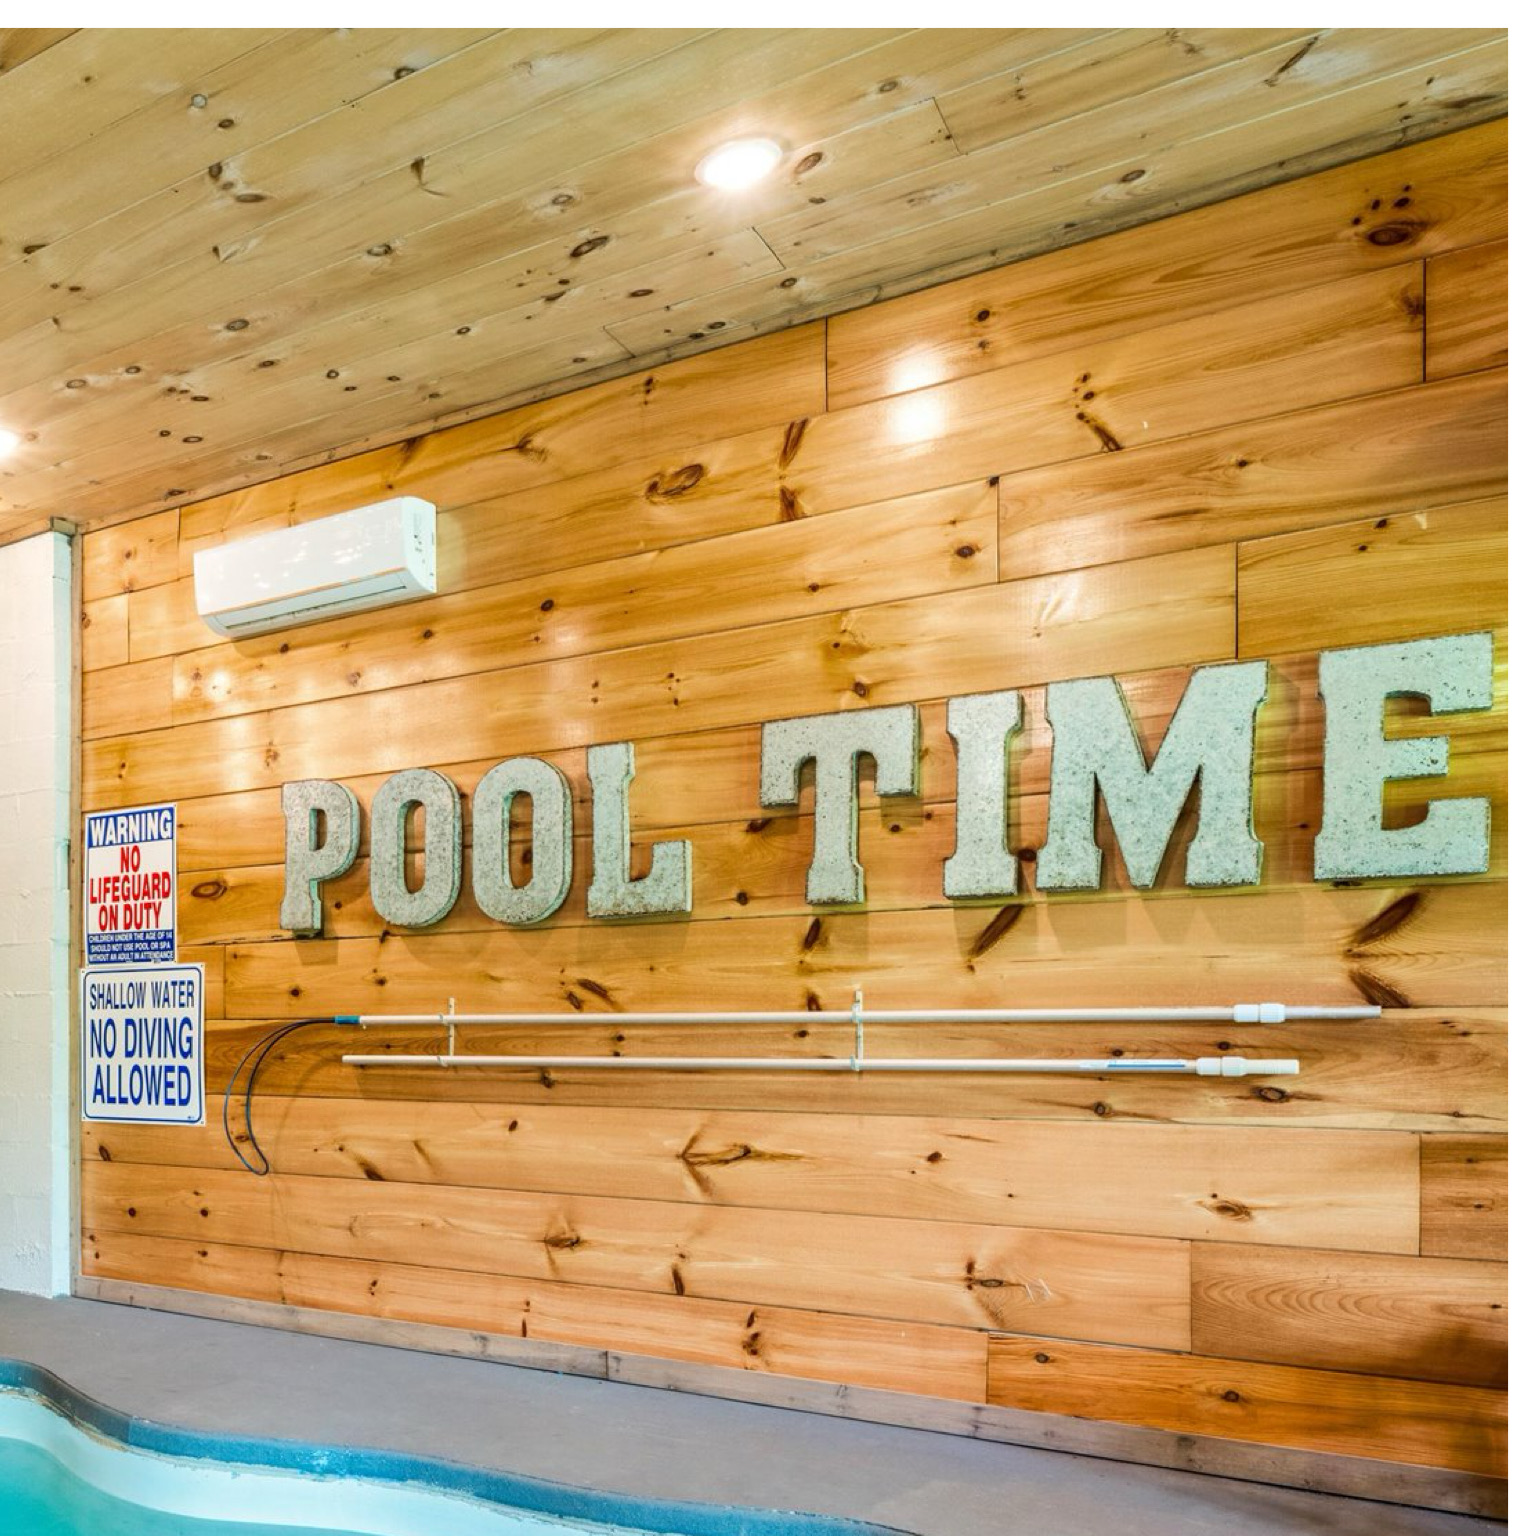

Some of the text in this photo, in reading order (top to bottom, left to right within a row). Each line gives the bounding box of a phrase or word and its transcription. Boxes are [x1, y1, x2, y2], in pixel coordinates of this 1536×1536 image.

[279, 632, 1496, 939] POOL TIME
[90, 809, 173, 847] WARNING
[120, 845, 141, 873] NO
[89, 871, 172, 905] LIFEGUARD
[98, 901, 162, 932] ON DUTY
[112, 943, 123, 952] NOT
[123, 942, 134, 951] USE
[135, 942, 150, 951] POOL
[160, 940, 171, 949] SPA
[134, 932, 144, 941] THE
[157, 931, 166, 940] OF
[89, 980, 195, 1010] SHALLOW WATER
[90, 1016, 193, 1060] NO DIVING
[92, 1064, 192, 1107] ALLOWED
